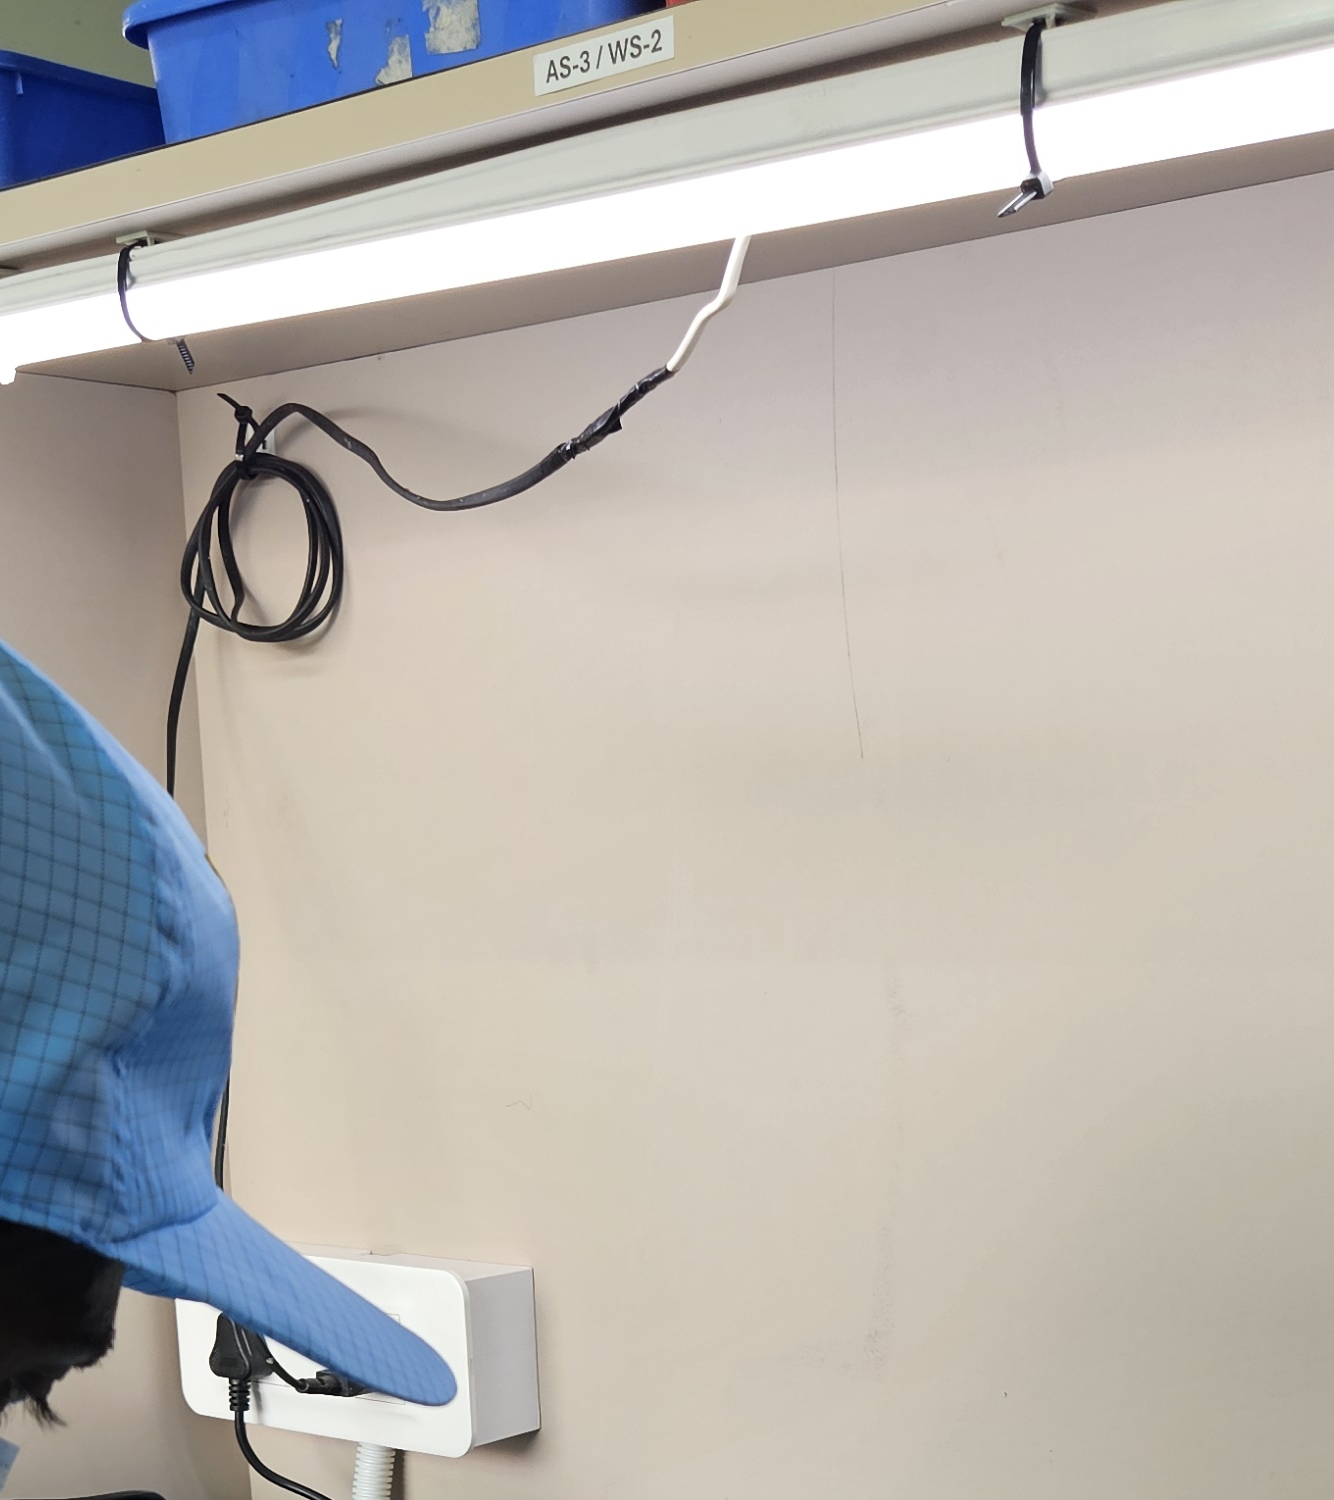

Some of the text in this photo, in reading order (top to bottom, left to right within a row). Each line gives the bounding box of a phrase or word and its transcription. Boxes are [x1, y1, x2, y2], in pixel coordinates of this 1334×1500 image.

[546, 29, 662, 83] AS-3 / WS-2
